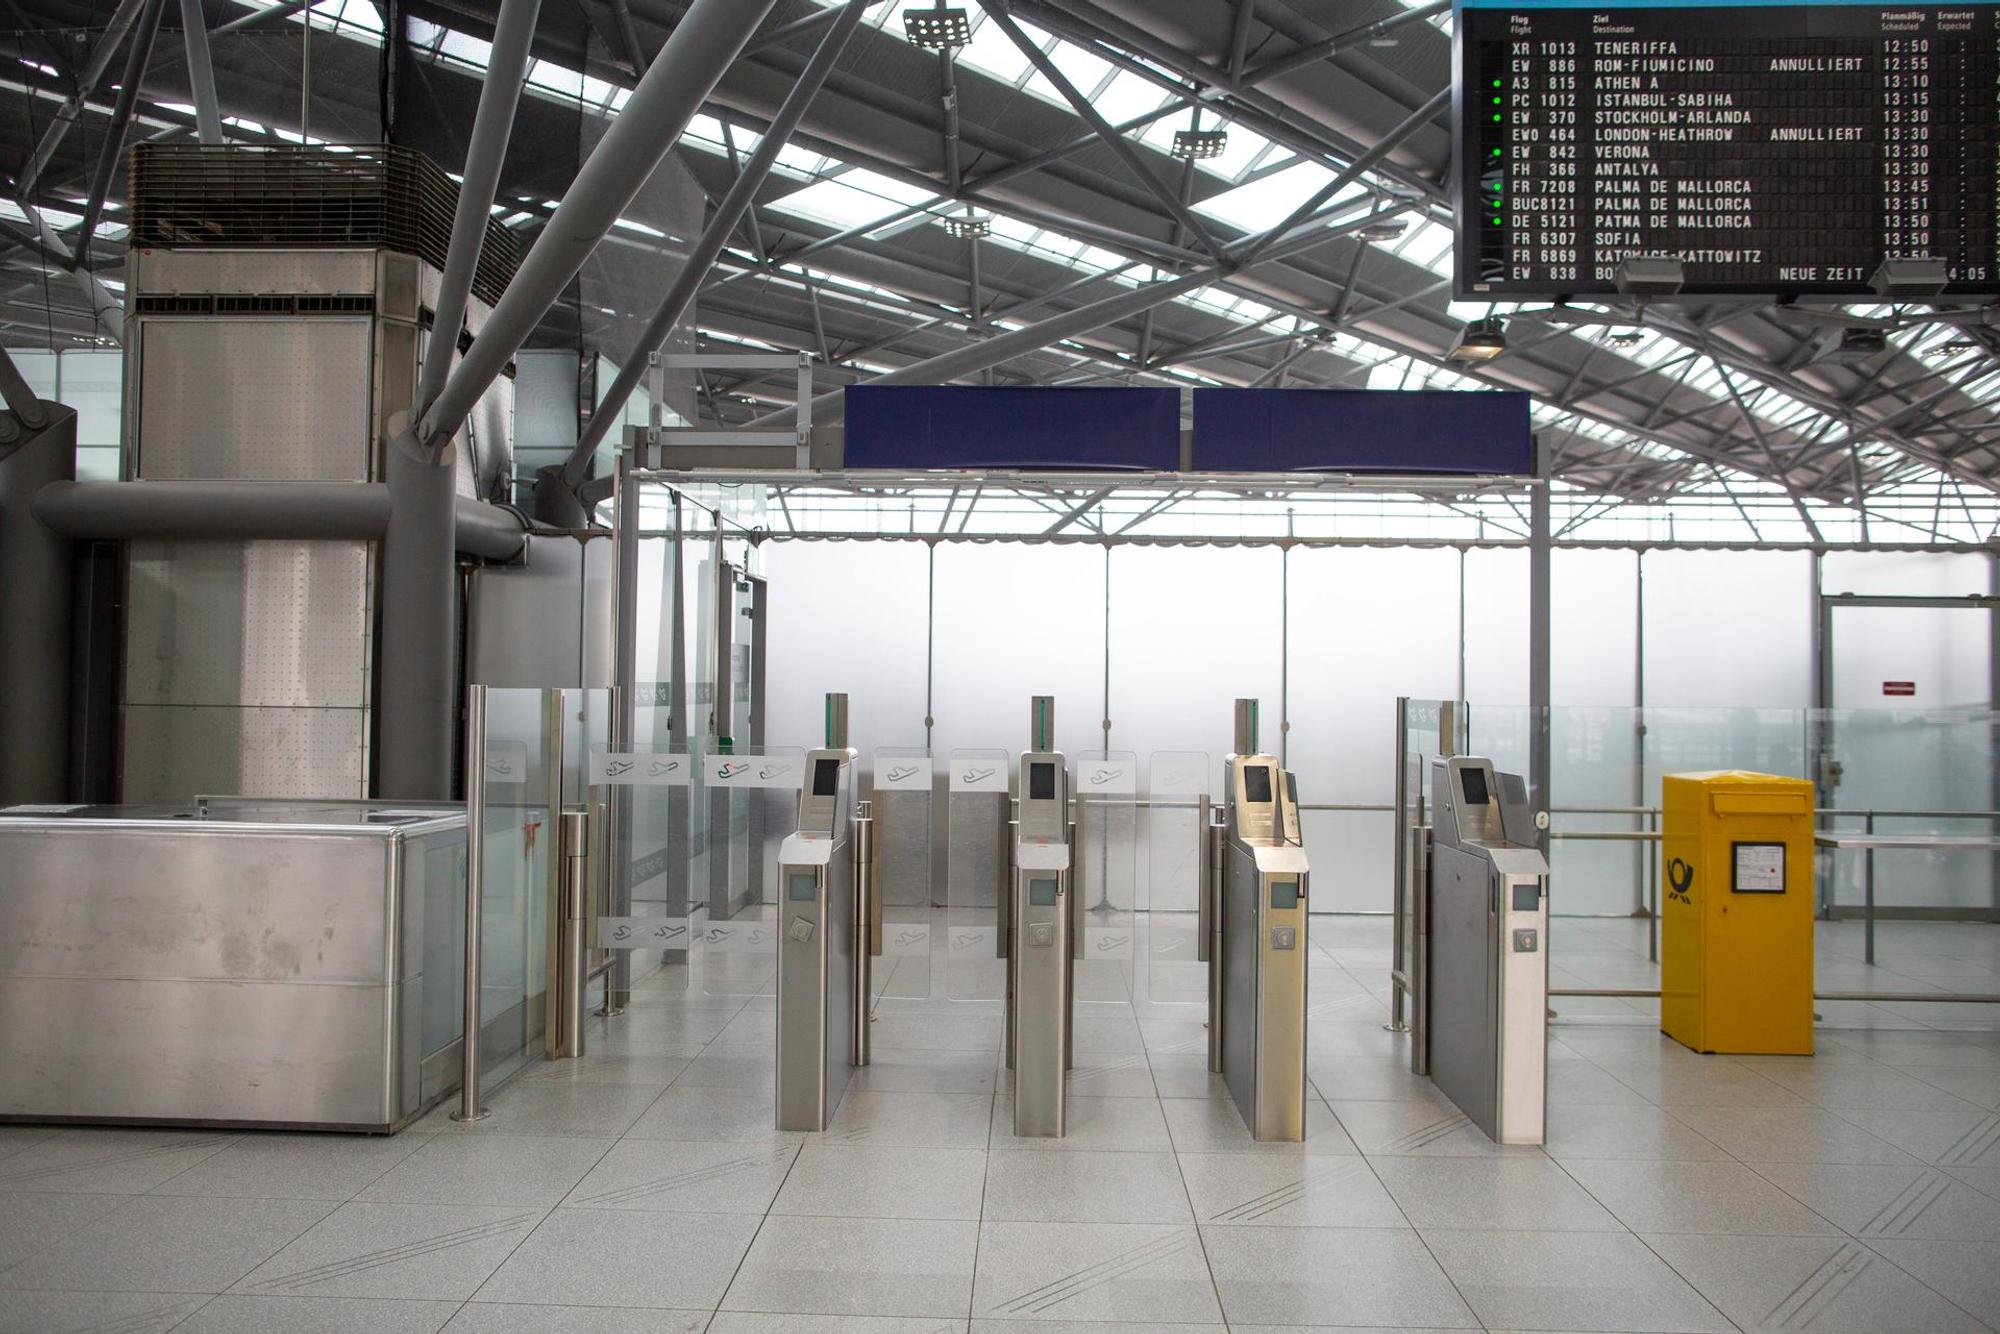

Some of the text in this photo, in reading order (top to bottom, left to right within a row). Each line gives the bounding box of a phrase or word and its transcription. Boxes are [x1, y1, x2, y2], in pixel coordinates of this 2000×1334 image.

[1510, 15, 1529, 25] Flug
[1593, 15, 1610, 24] Ziel
[1937, 11, 1975, 21] Erwartet
[1510, 25, 1532, 35] Flight
[1593, 25, 1635, 34] Destination
[1881, 22, 1920, 31] Scheduled
[1937, 22, 1972, 32] Expected
[1512, 40, 1929, 55] XR 1013 TENERIFFA 12:50
[1512, 57, 1929, 72] EW 886 ROM-FIUMICINO ANNULLIERT 12:55
[1512, 75, 1929, 90] A3 815 ATHEN A 13:10
[1512, 92, 1929, 107] PC 1012 ISTANBUL-SABIHA 13:15
[1512, 109, 1929, 124] EW 370 STOCKHOLM-ARLANDA 13:30
[1549, 128, 1576, 141] 464
[1595, 128, 1733, 141] LONDON-HEATHROW
[1769, 128, 1863, 141] ANNULLIERT
[1883, 126, 1929, 140] 13:30
[1512, 144, 1929, 158] EW 842 VERONA 13:30
[1512, 161, 1929, 176] FH 366 ANTALYA 13:30
[1512, 178, 1929, 193] FR 7208 PALMA DE MALLORCA 13:45
[1595, 198, 1641, 210] PALMA
[1650, 198, 1668, 210] DE
[1677, 198, 1752, 210] MALLORCA
[1883, 196, 1929, 209] 13:51
[1512, 215, 1530, 228] DE
[1541, 215, 1576, 228] 5121
[1650, 215, 1668, 228] DE
[1677, 215, 1752, 228] MALLORCA
[1883, 213, 1929, 227] 13:50
[1512, 230, 1929, 245] FR 6307 SOFIA 13:50
[1512, 250, 1530, 263] FR
[1541, 250, 1576, 263] 6869
[1512, 267, 1530, 280] EW
[1550, 267, 1576, 280] 838
[1779, 268, 1817, 281] NEUE
[1826, 268, 1864, 281] ZEIT
[1944, 267, 1986, 280] 4:05
